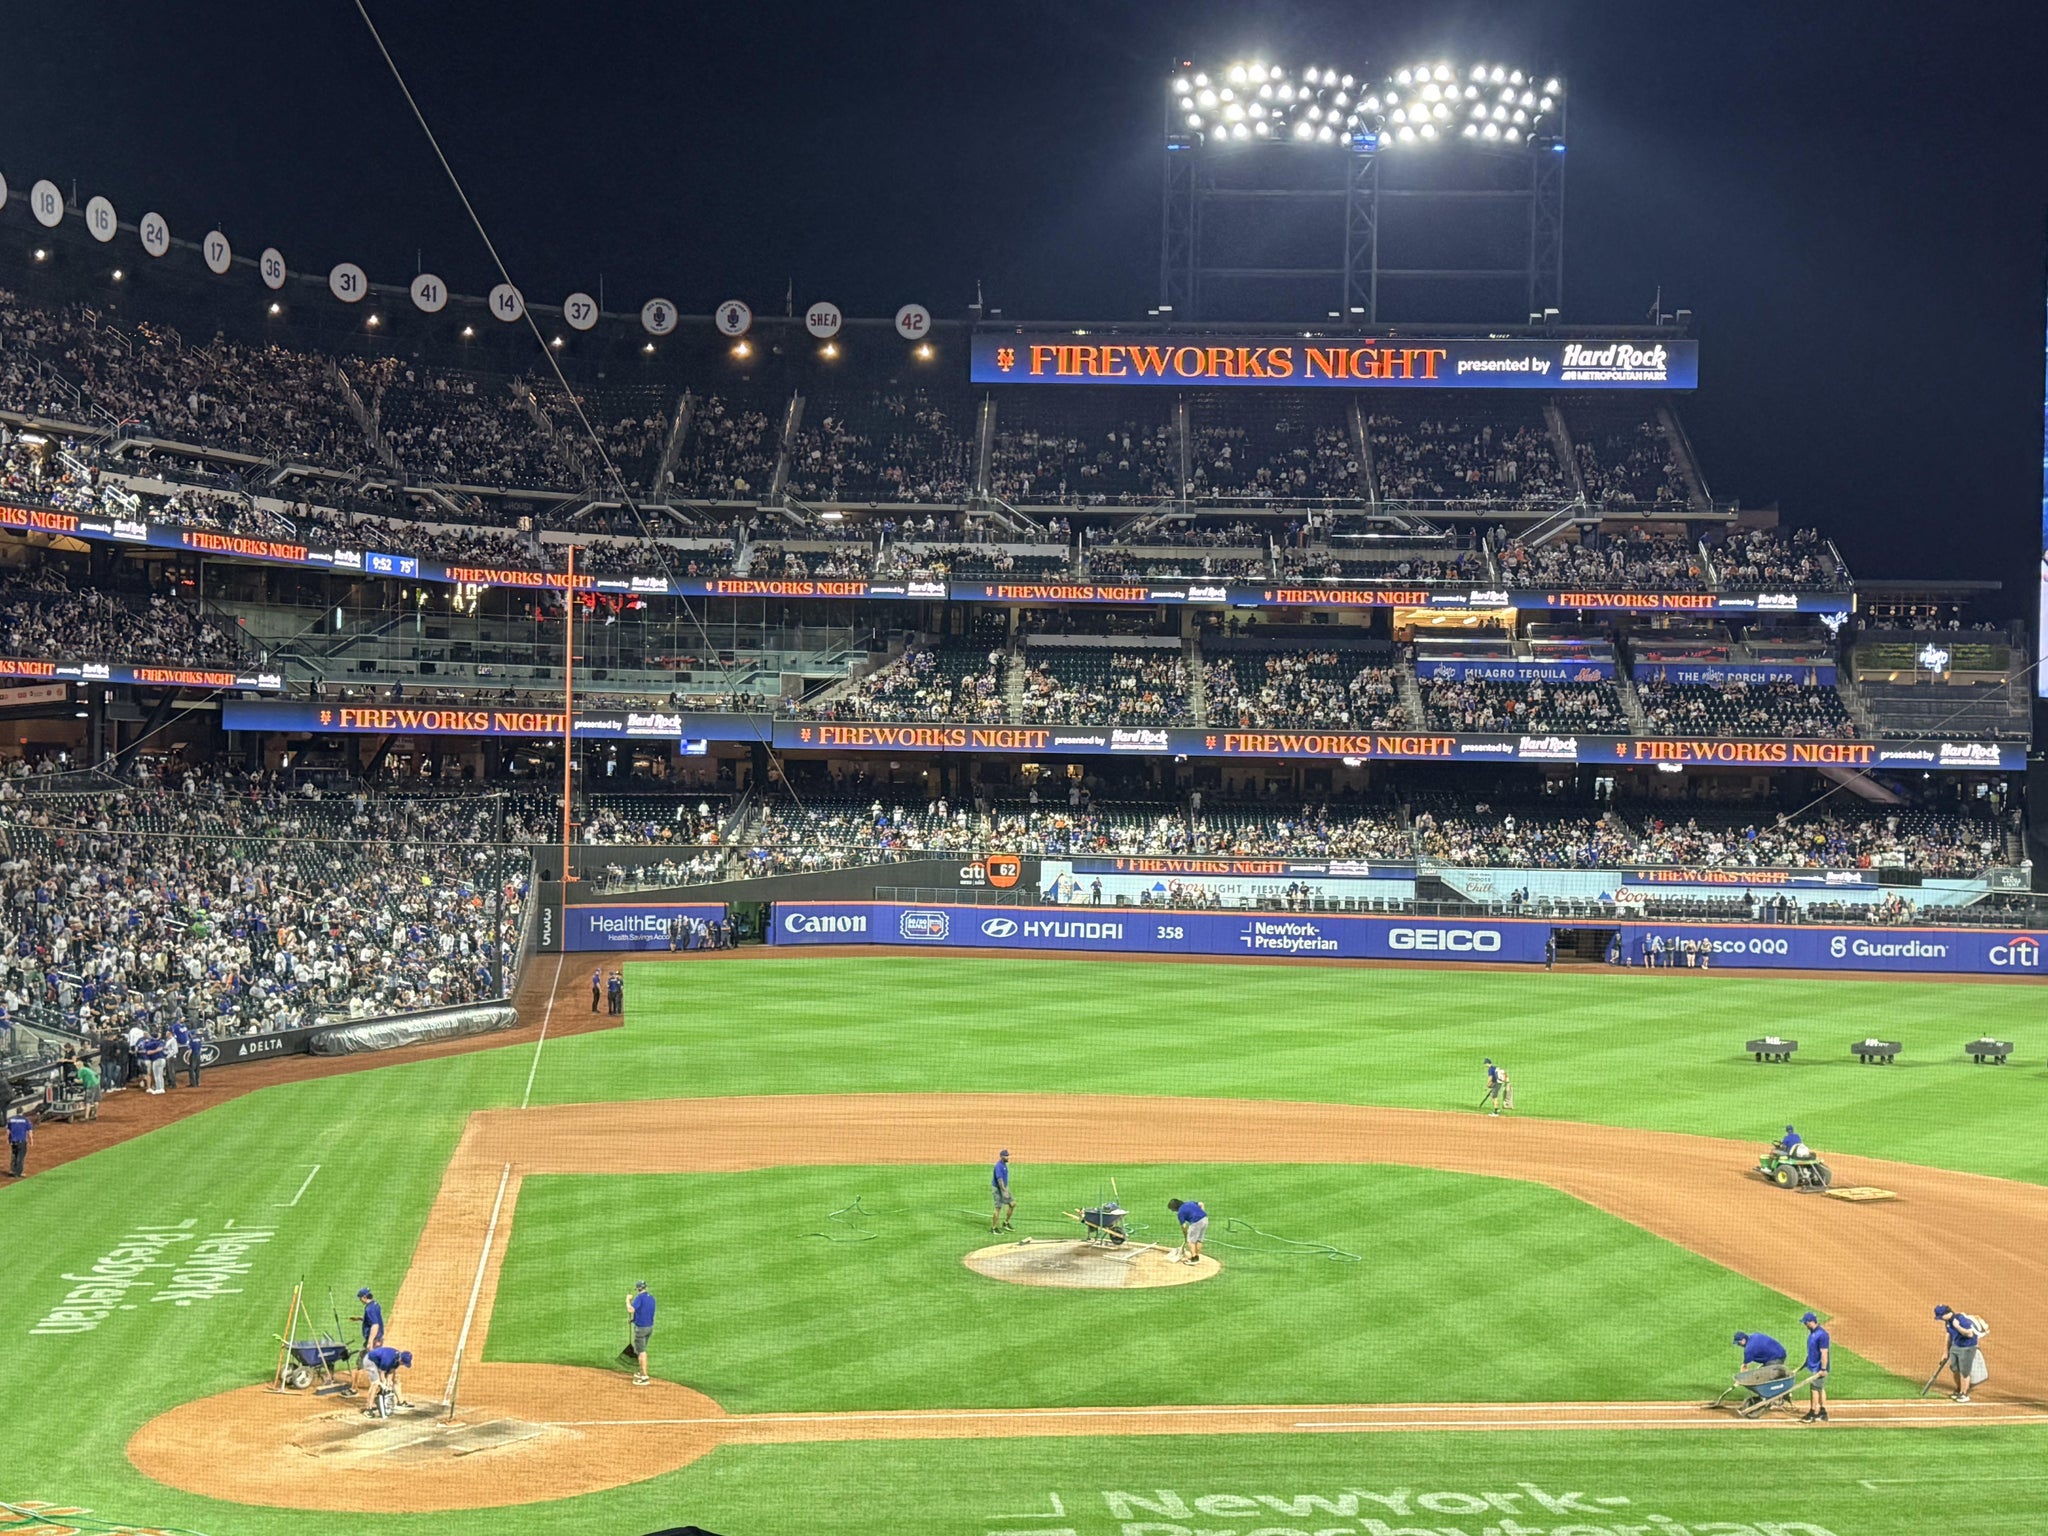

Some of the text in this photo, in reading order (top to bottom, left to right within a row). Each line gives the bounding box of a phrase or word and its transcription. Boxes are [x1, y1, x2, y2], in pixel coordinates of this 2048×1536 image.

[40, 193, 55, 214] 18
[94, 209, 109, 231] 16
[145, 224, 163, 246] 24
[210, 243, 225, 261] 17
[264, 258, 281, 279] 36
[340, 273, 358, 292] 31
[419, 284, 438, 302] 41
[498, 294, 515, 312] 14
[571, 303, 591, 321] 37
[810, 313, 838, 328] SHEA
[902, 313, 924, 330] 42
[1030, 345, 1294, 378] FIREWORKS
[1304, 348, 1447, 379] NIGHT
[1457, 357, 1530, 374] presented
[1532, 357, 1550, 375] by
[1563, 344, 1668, 371] Hard Rock
[1577, 366, 1641, 381] METROPOLITAN
[1643, 366, 1668, 381] PARK
[30, 508, 79, 532] NIGHT
[192, 532, 267, 556] FIREWORKS
[269, 543, 307, 561] NIGHT
[453, 568, 543, 586] FIREWORKS
[717, 580, 814, 595] FIREWORKS
[816, 582, 868, 595] NIGHT
[998, 586, 1094, 599] FIREWORKS
[1097, 587, 1149, 600] NIGHT
[1276, 589, 1374, 604] FIREWORKS
[1377, 591, 1430, 604] NIGHT
[1560, 594, 1660, 607] FIREWORKS
[1662, 595, 1717, 608] NIGHT
[17, 661, 56, 676] NIGHT
[1465, 668, 1567, 680] MILAGRO TEQUILA
[1677, 671, 1699, 681] THE
[141, 669, 203, 683] FIREWORKS
[204, 672, 236, 686] NIGHT
[339, 708, 489, 731] FIREWORKS
[574, 720, 612, 730] presented
[613, 720, 623, 731] by
[818, 725, 1106, 749] FIREWORKS NIGHT presented by
[1223, 733, 1514, 756] FIREWORKS NIGHT presented by
[1518, 736, 1578, 752] Hard Rock
[1634, 740, 1935, 764] FIREWORKS NIGHT presented by
[1939, 743, 2001, 757] Hard Rock
[960, 863, 985, 879] citi
[1000, 864, 1016, 876] 62
[1128, 858, 1230, 874] FIREWORKS
[1233, 860, 1288, 875] NIGHT
[1207, 884, 1242, 894] LIGHT
[1466, 882, 1492, 893] Chill
[542, 908, 552, 946] 335
[784, 913, 867, 933] Canon
[1023, 921, 1123, 939] HYUNDAI
[1255, 921, 1320, 936] NewYork-
[629, 934, 653, 942] Savings
[1157, 926, 1184, 940] 358
[1388, 928, 1501, 952] GEICO
[1255, 935, 1338, 951] Presbyterian
[1749, 938, 1788, 955] QQQ
[1852, 939, 1946, 957] Guardian
[1989, 943, 2039, 967] citi
[250, 1039, 283, 1053] DELTA
